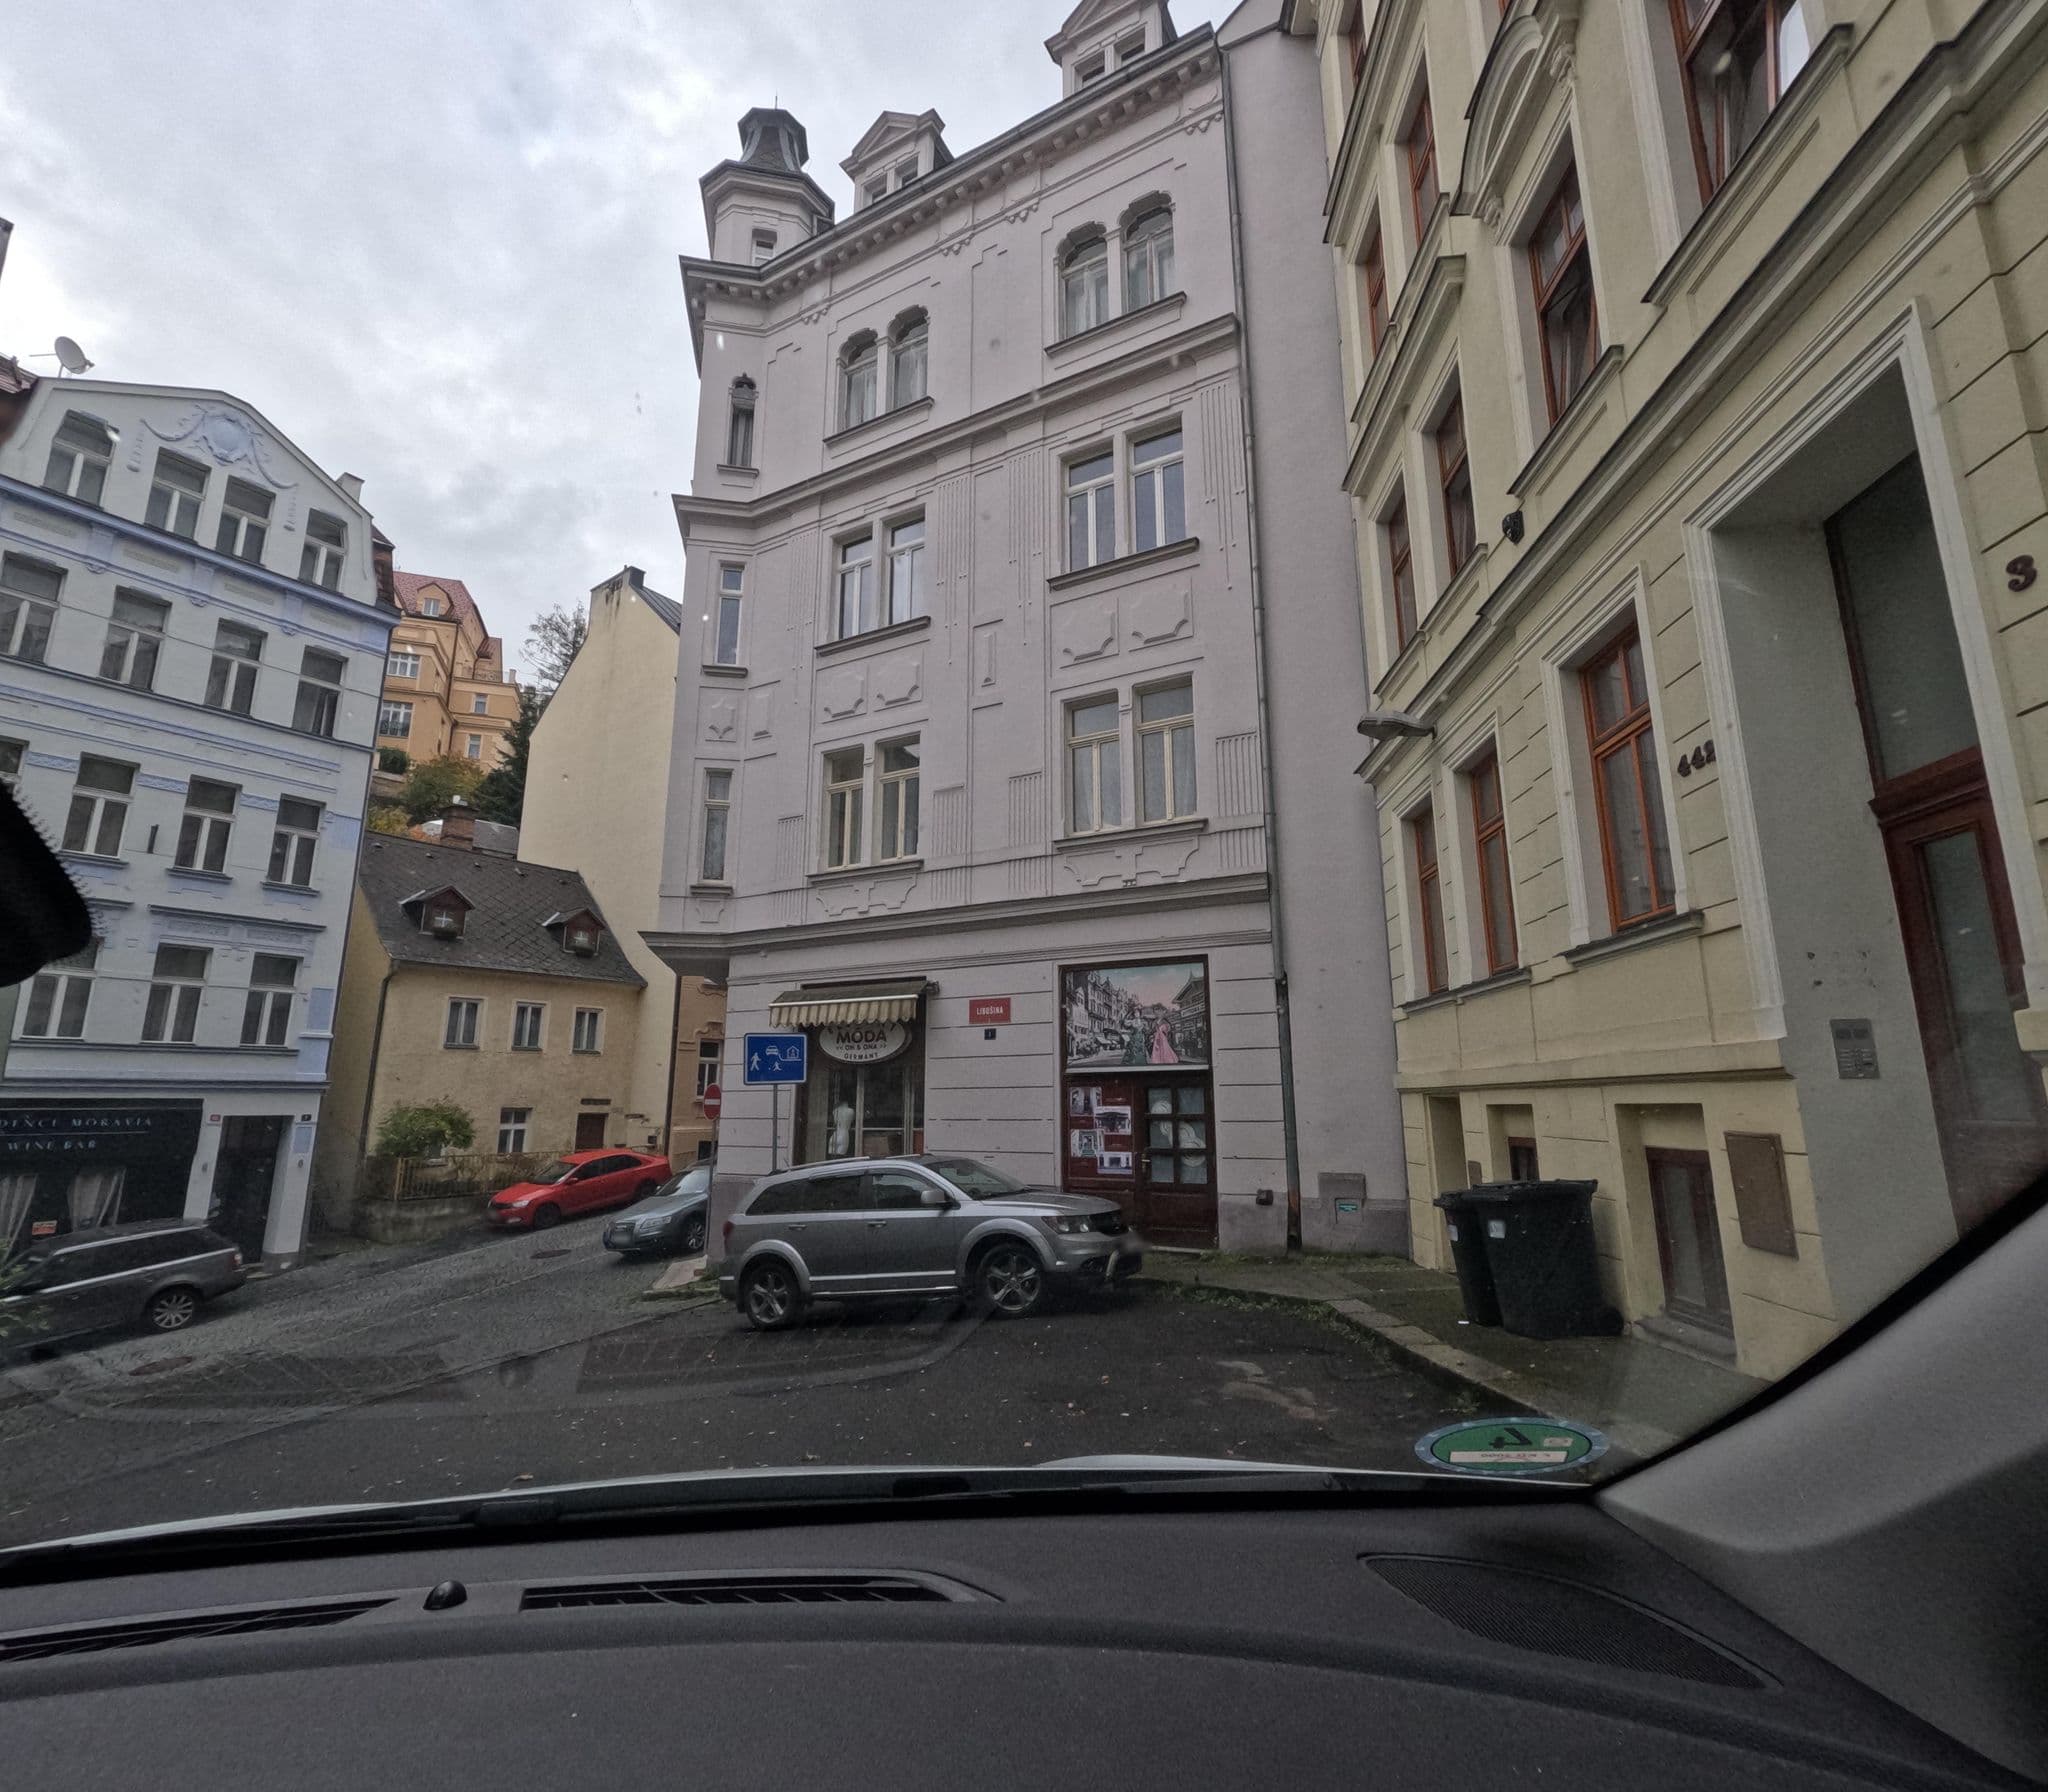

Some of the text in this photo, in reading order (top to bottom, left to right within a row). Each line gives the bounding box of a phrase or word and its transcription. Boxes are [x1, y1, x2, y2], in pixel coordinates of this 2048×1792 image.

[2006, 555, 2037, 592] 3
[836, 1030, 887, 1044] MODA
[72, 1117, 152, 1128] MORAVIA
[8, 1140, 97, 1151] WINE BAR
